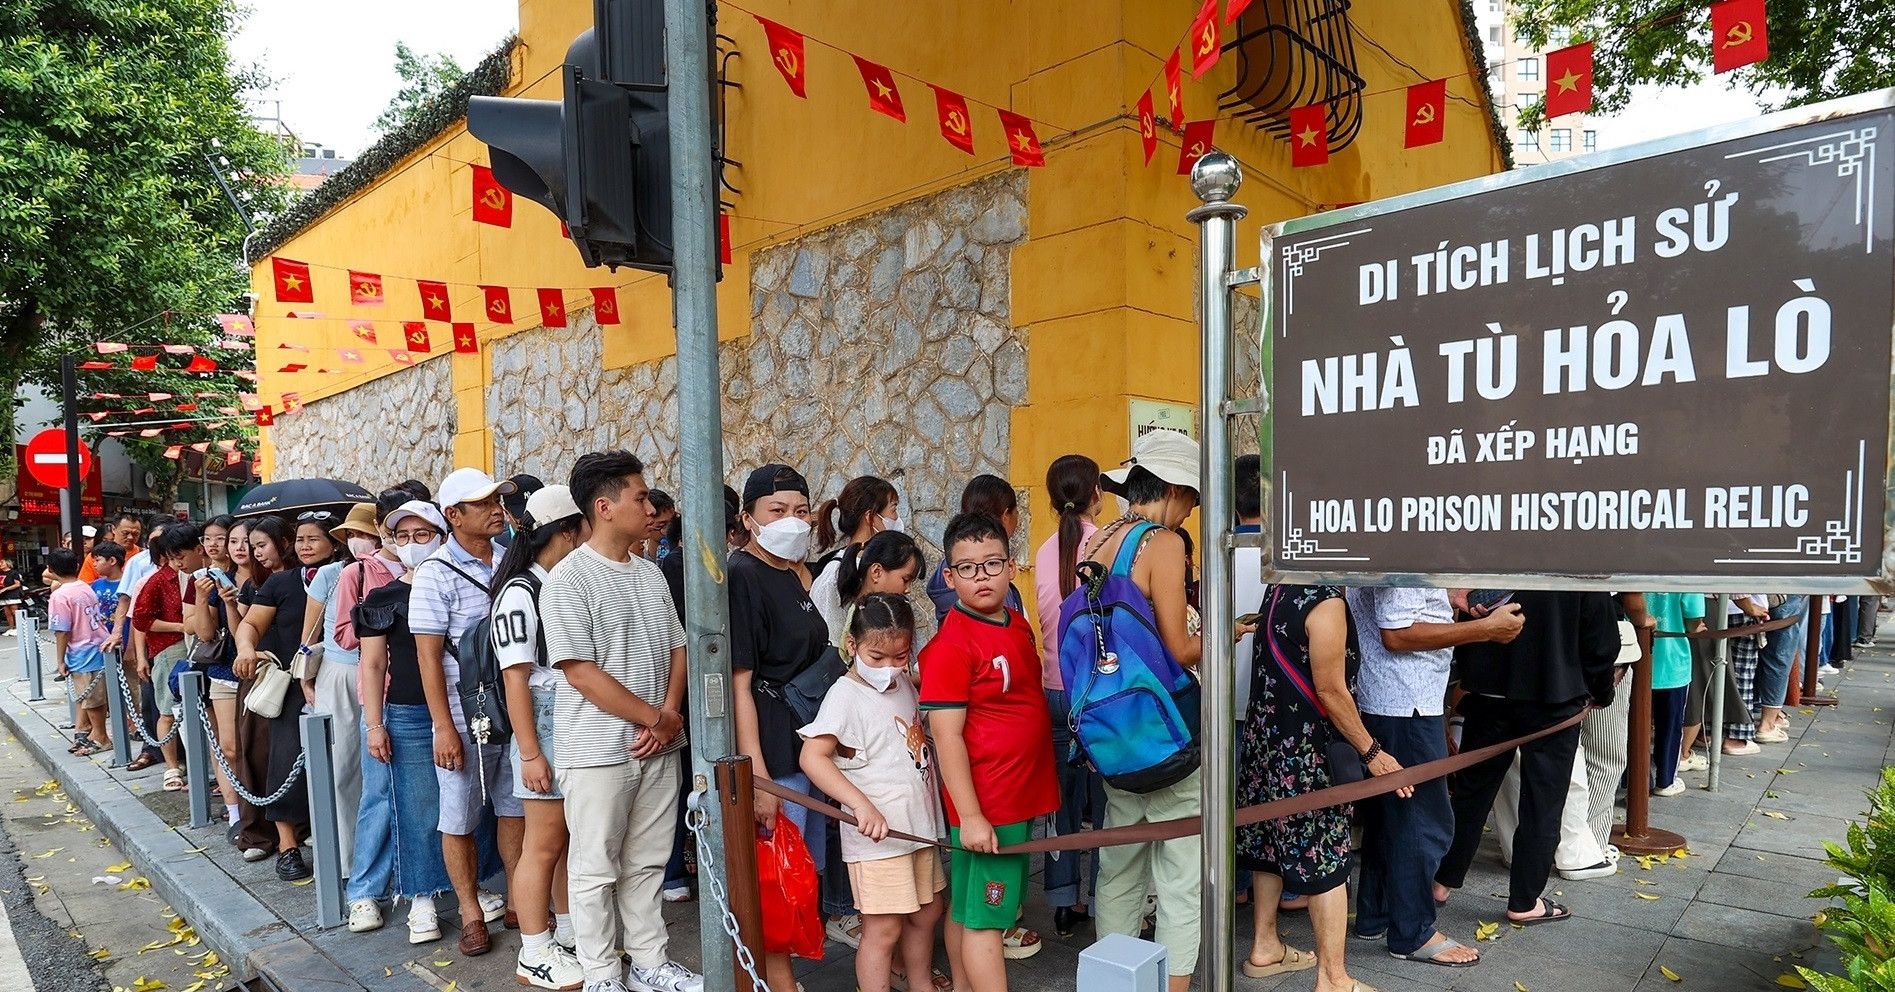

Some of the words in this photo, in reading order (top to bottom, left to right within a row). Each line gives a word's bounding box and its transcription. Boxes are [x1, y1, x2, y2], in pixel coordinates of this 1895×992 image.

[1359, 260, 1398, 306] DI
[1411, 238, 1509, 297] TÍCH
[1525, 215, 1636, 288] LỊCH
[1653, 179, 1739, 258] SỬ
[1301, 334, 1420, 417] NHÀ
[1438, 322, 1518, 404] TÙ
[1543, 289, 1697, 395] HỎA
[1725, 278, 1831, 379] LÒ
[1426, 427, 1466, 465] ĐÃ
[1475, 419, 1536, 464] XẾP
[1546, 422, 1639, 466] HẠNG
[1310, 498, 1357, 534] HOA
[1363, 497, 1393, 533] LO
[1401, 494, 1502, 533] PRISON
[1510, 487, 1694, 532] HISTORICAL
[1704, 484, 1809, 530] RELIC
[494, 610, 528, 648] 00
[992, 654, 1011, 693] 7
